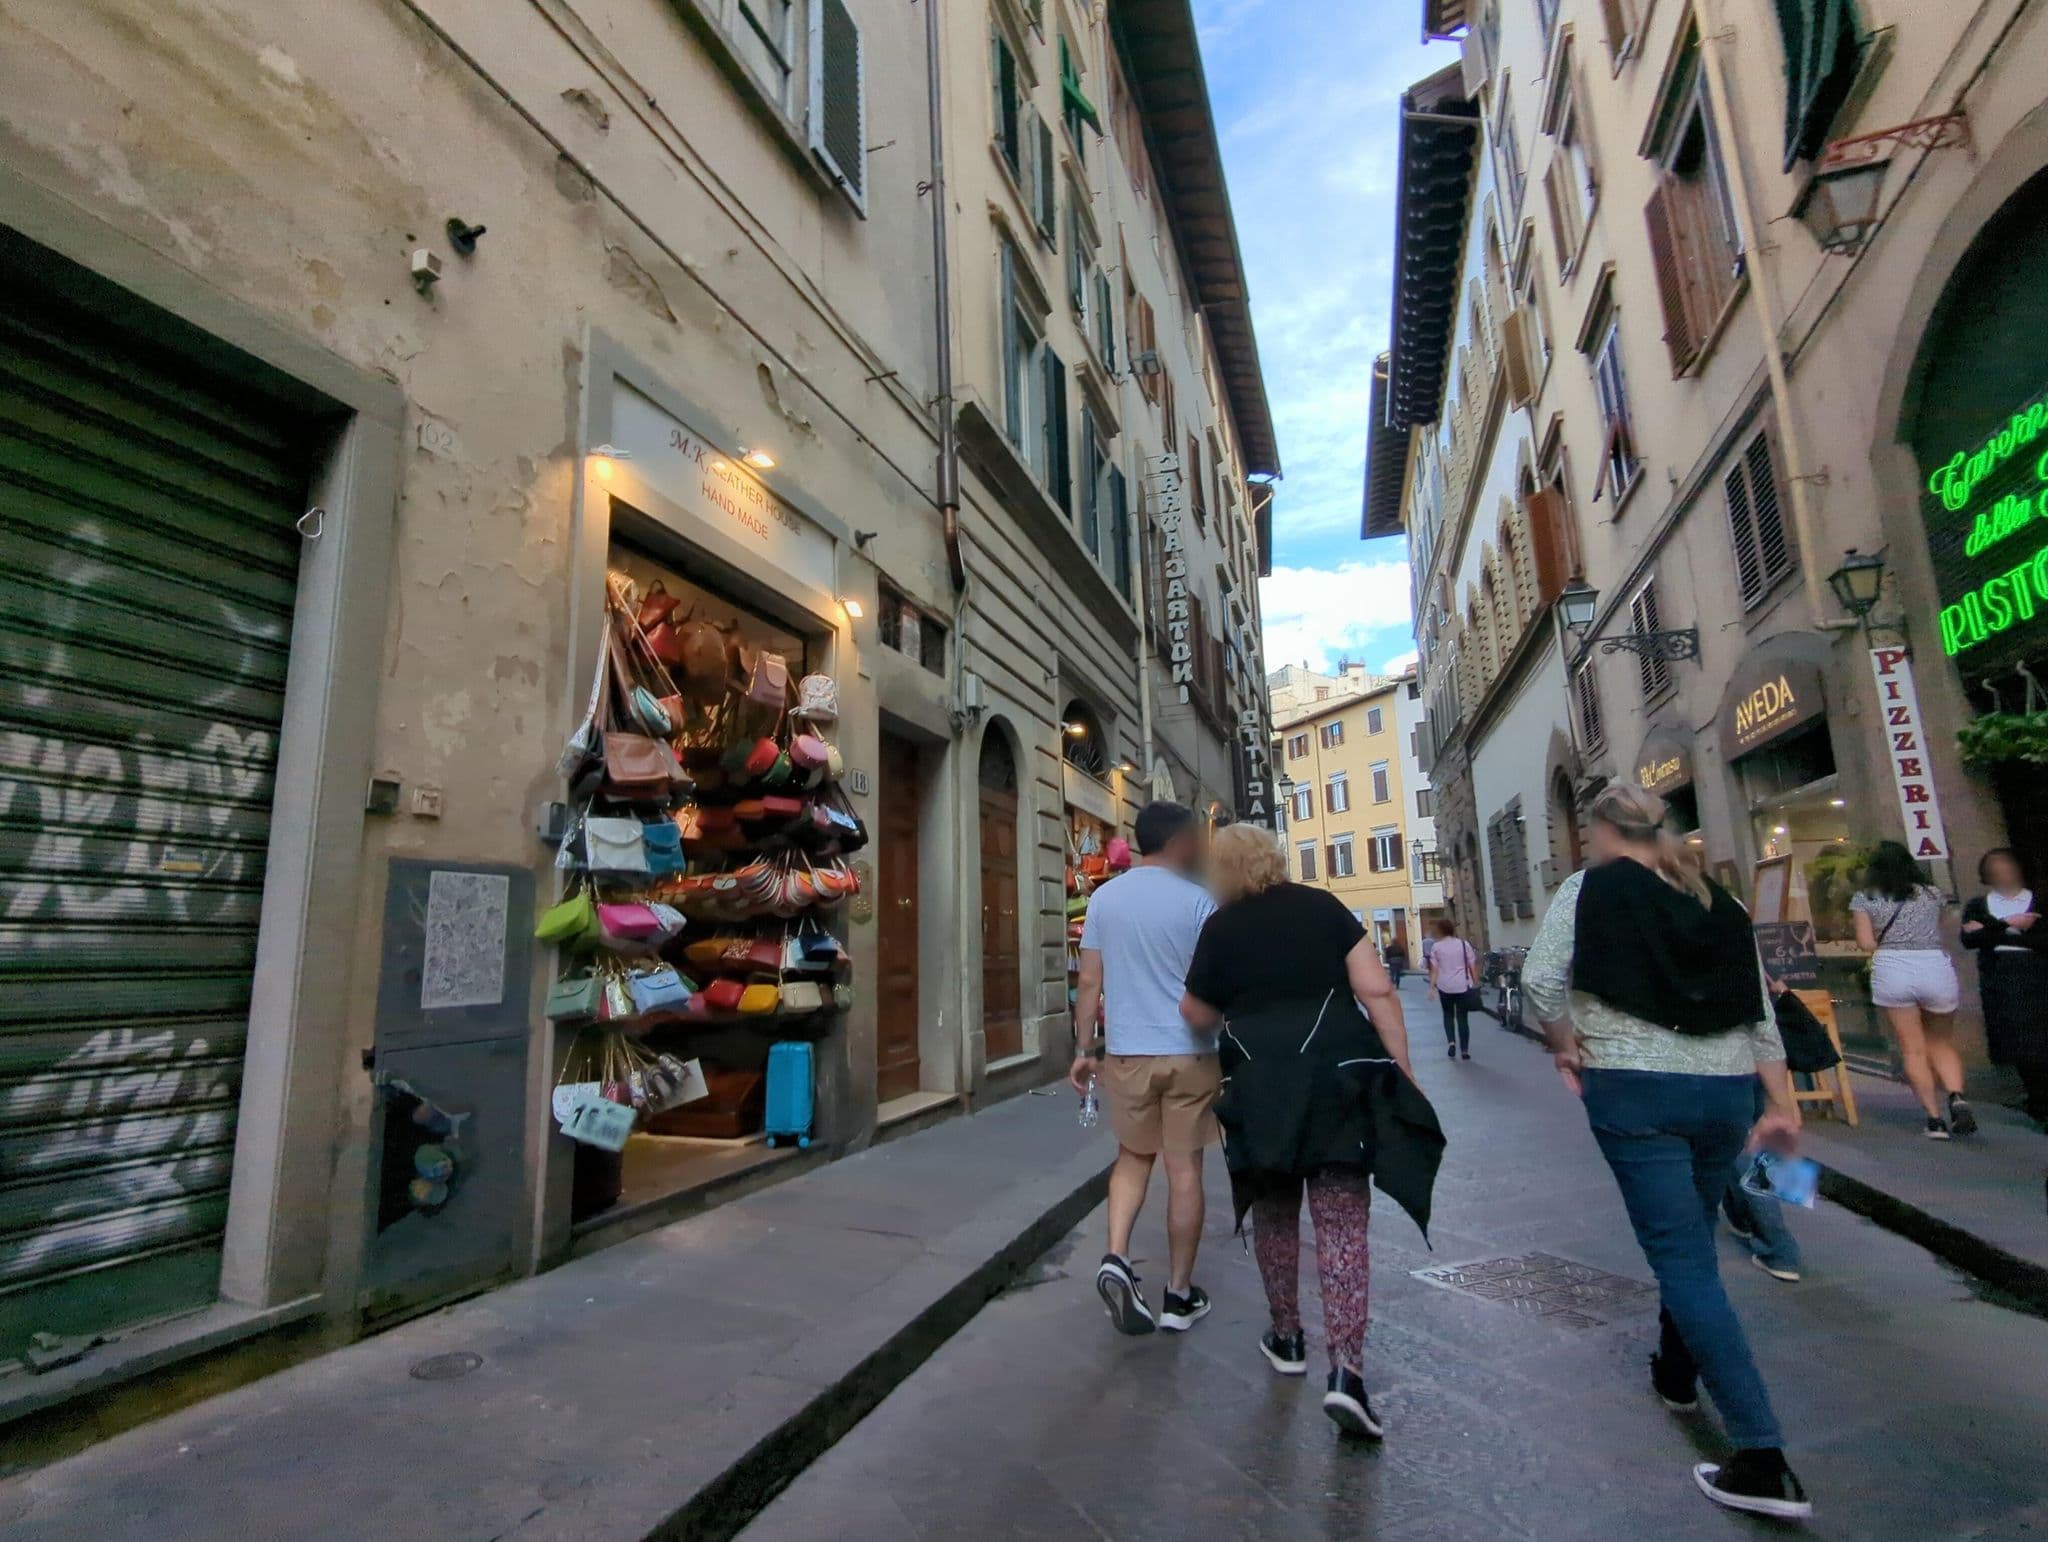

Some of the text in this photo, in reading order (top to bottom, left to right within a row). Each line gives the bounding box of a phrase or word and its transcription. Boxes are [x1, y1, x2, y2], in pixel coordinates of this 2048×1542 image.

[702, 481, 768, 540] HAND MADE
[765, 501, 801, 536] HOUSE
[1965, 494, 2030, 557] della
[1736, 674, 1795, 735] AVEDA
[855, 772, 866, 791] 18
[1874, 650, 1941, 856] PIZZERIA
